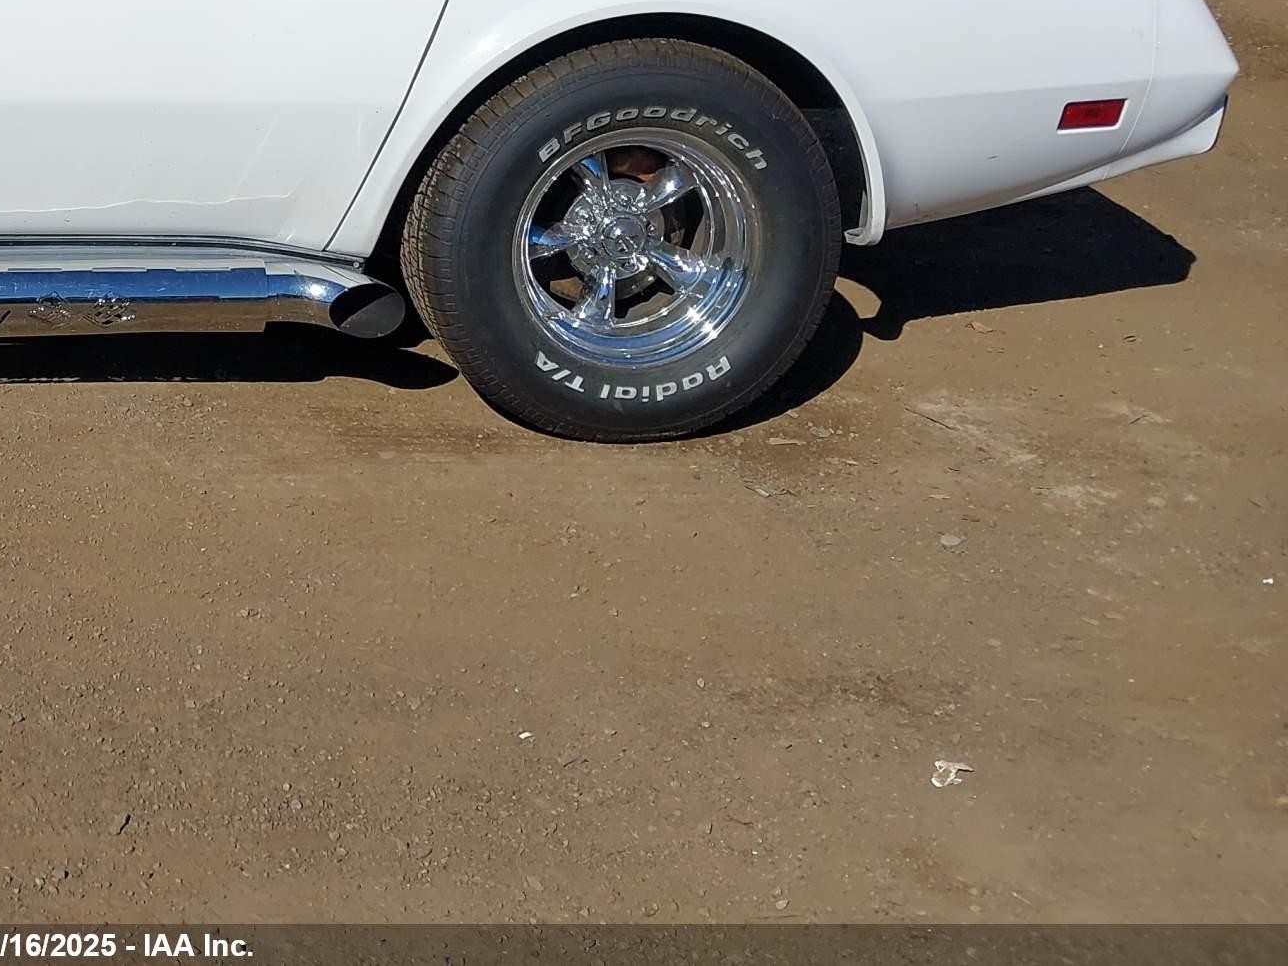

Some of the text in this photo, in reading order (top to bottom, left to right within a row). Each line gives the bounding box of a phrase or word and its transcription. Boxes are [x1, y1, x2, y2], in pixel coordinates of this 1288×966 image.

[537, 106, 769, 171] BFGoodrich
[535, 350, 731, 403] Radial T/A
